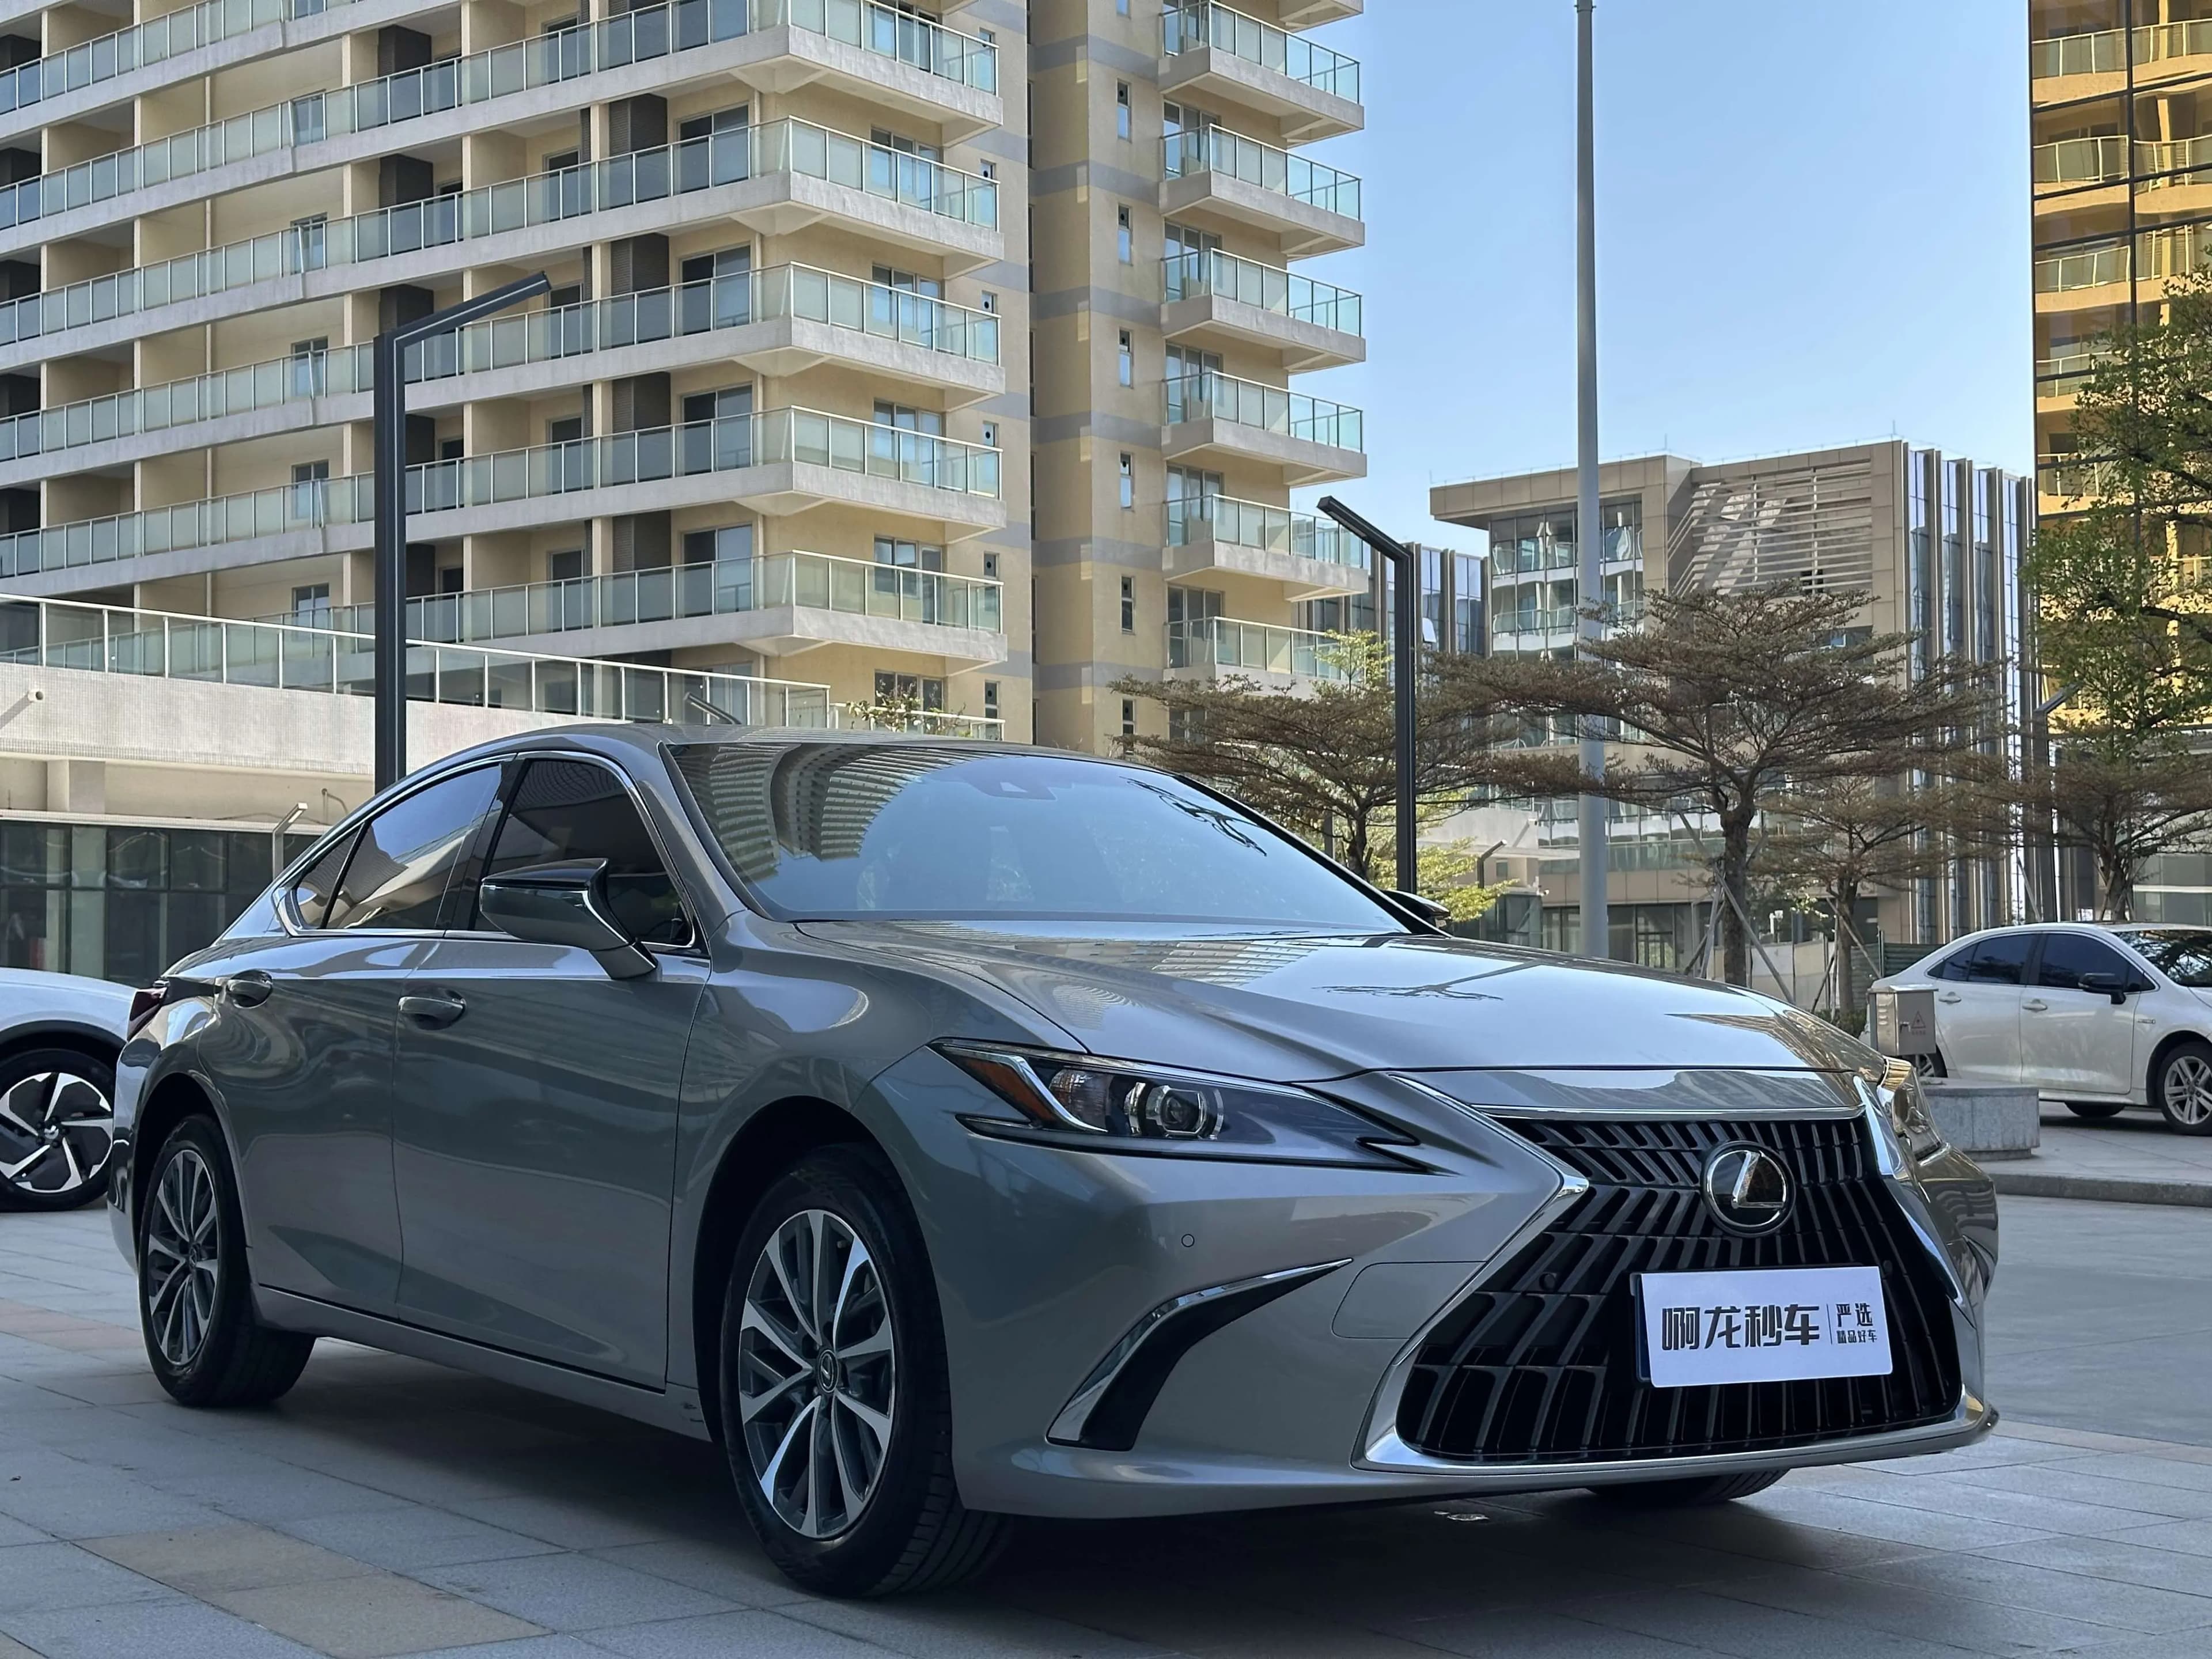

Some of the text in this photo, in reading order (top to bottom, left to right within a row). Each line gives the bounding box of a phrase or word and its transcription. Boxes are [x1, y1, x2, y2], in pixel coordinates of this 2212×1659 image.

[1661, 1304, 1820, 1351] 啊龙秒车
[1836, 1302, 1873, 1328] 严选
